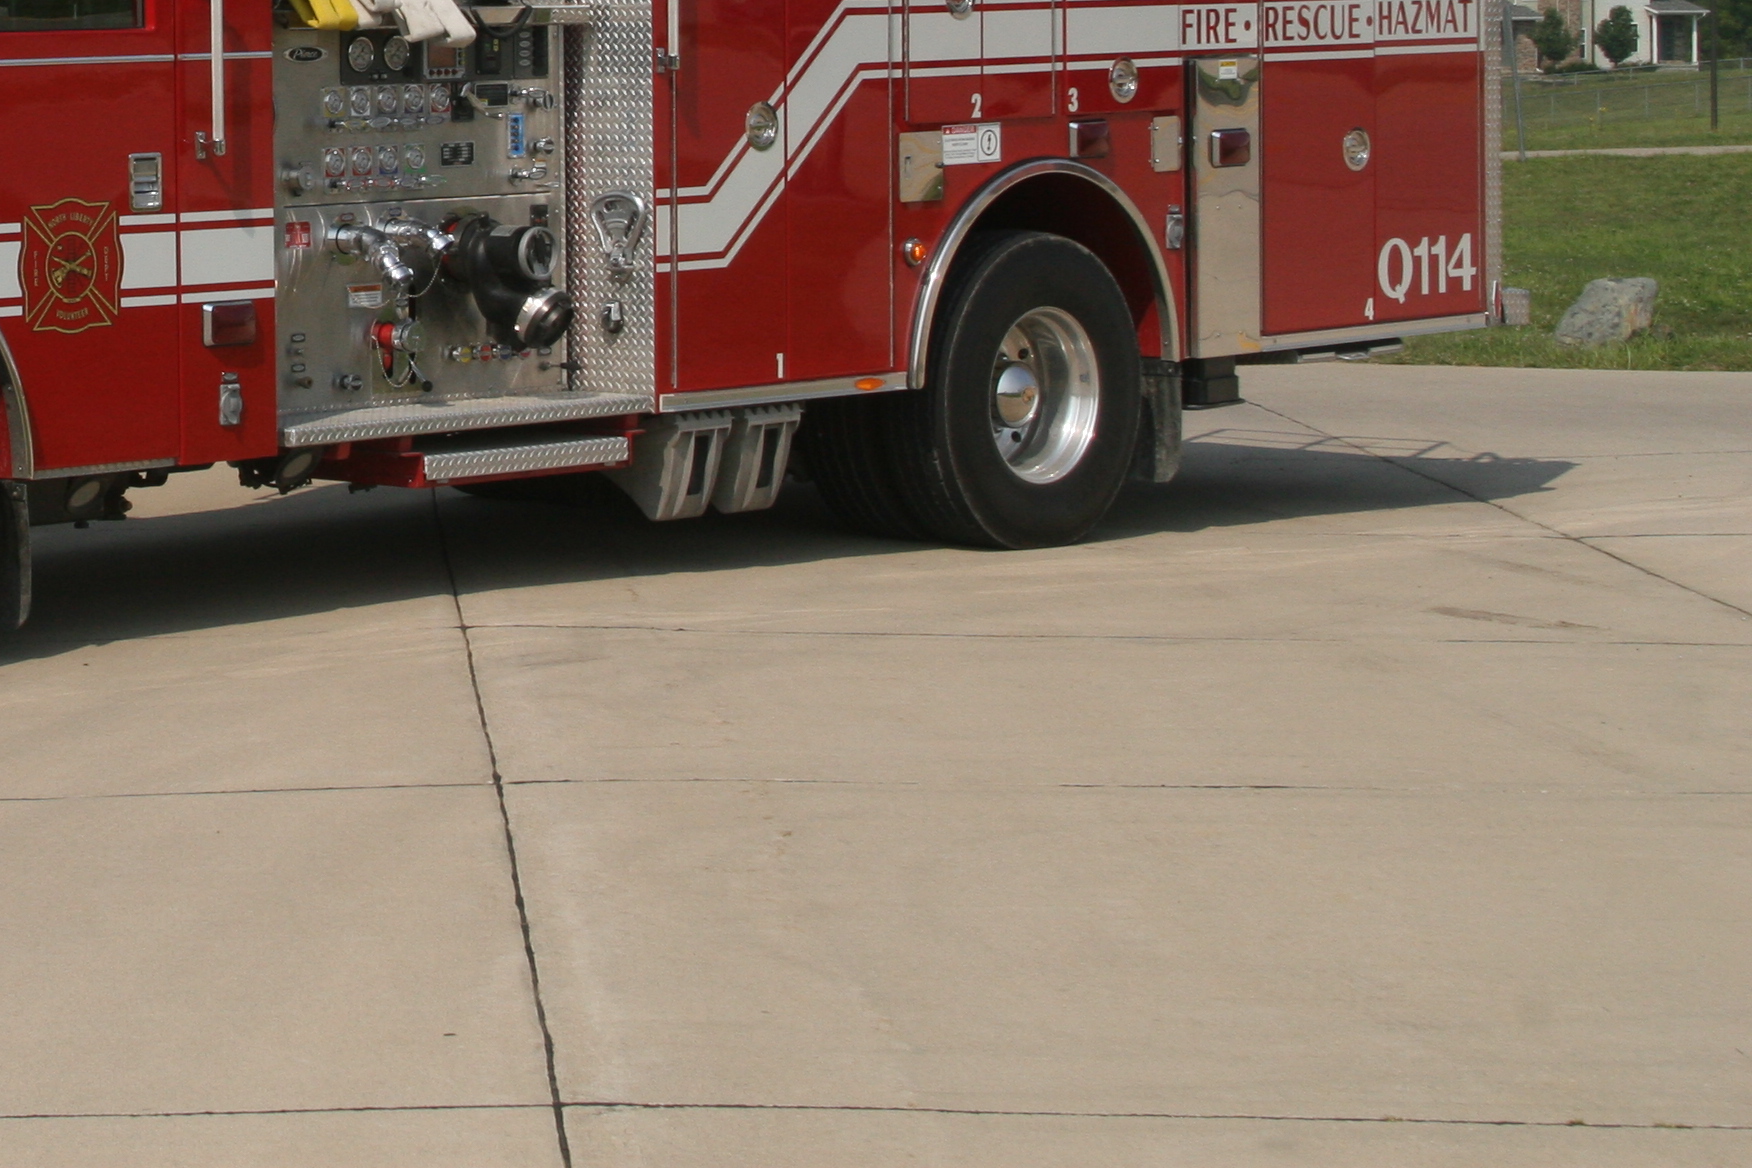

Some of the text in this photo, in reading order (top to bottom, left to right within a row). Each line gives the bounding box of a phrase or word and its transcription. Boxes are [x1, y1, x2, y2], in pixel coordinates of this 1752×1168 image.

[1181, 7, 1238, 45] FIRE
[1263, 3, 1361, 42] RESCUE
[970, 93, 982, 118] 2
[1067, 87, 1079, 112] 3
[1377, 232, 1477, 304] Q114
[1364, 297, 1374, 320] 4
[776, 352, 784, 379] 1
